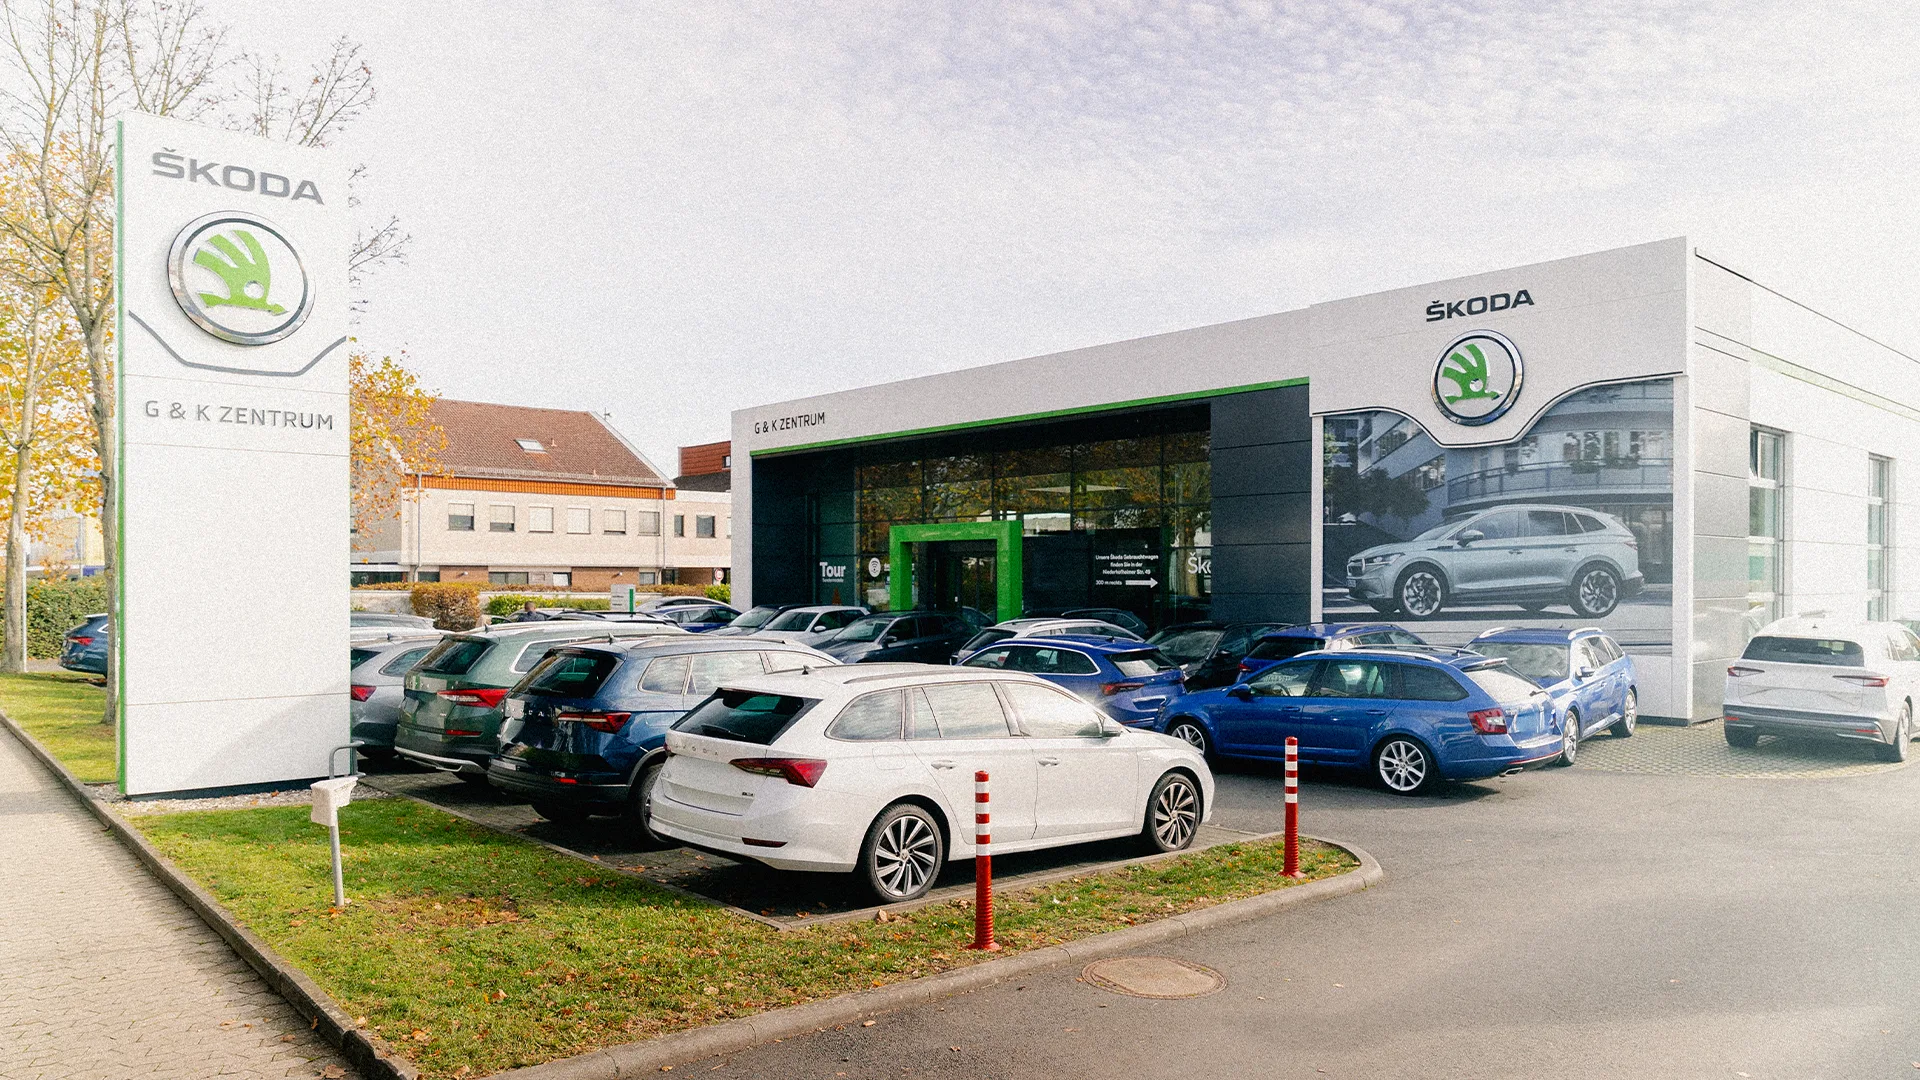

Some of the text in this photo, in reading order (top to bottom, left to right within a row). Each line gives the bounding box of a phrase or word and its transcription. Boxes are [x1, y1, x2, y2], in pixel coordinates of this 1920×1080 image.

[152, 146, 325, 206] ŠKODA
[1426, 289, 1535, 322] ŠKODA
[145, 400, 334, 431] G & K ZENTRUM
[754, 412, 825, 434] G & K ZENTRUM
[819, 561, 846, 578] Tour
